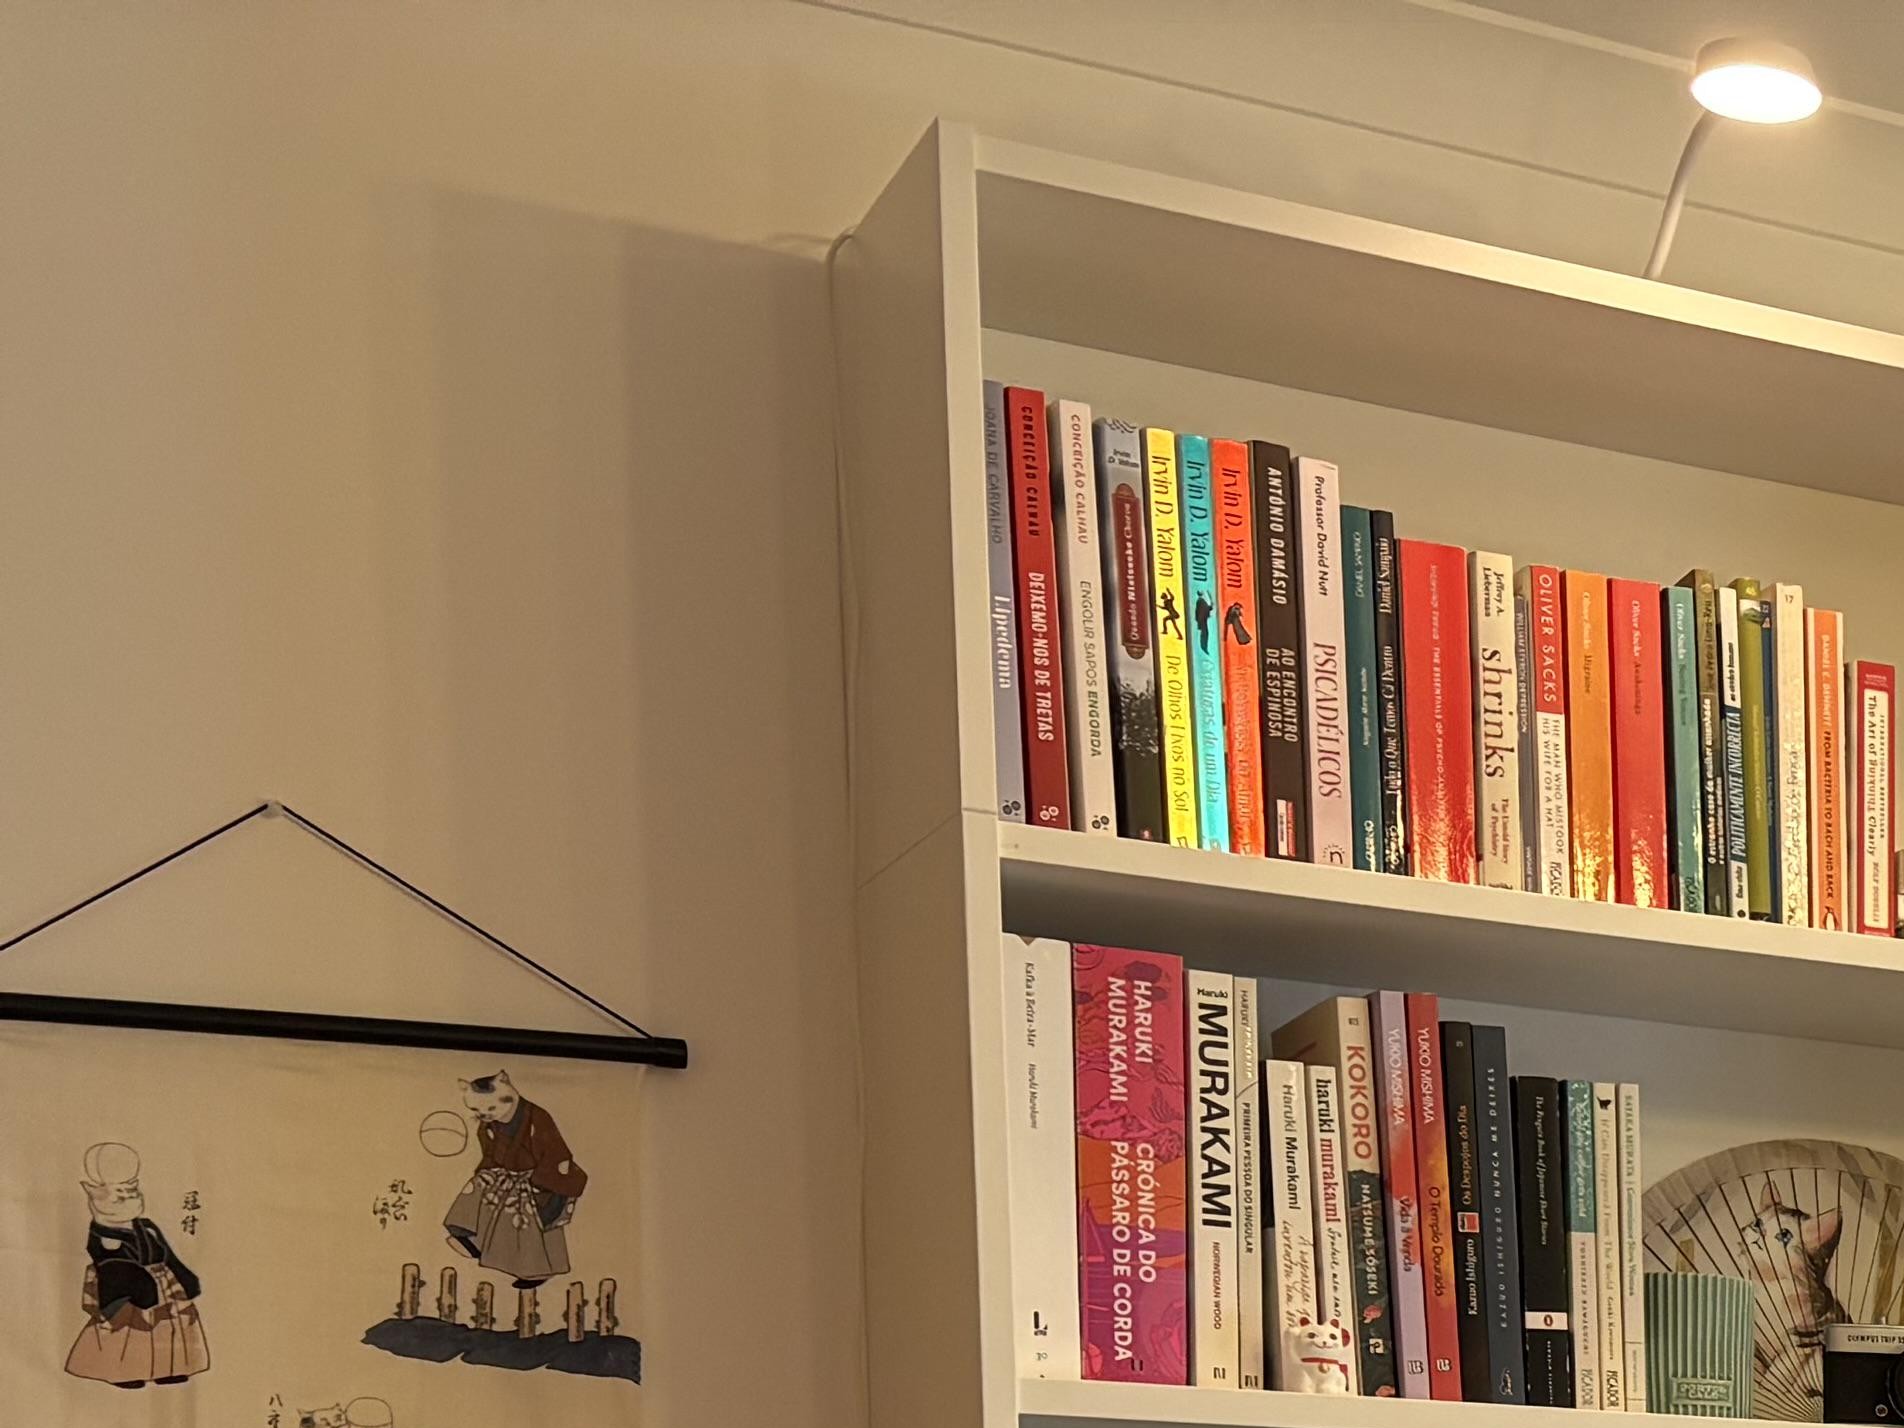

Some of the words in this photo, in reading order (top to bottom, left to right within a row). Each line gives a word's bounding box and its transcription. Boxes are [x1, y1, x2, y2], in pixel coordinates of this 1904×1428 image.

[1151, 456, 1170, 496] Irvin
[1187, 460, 1205, 502] Irvin
[1267, 466, 1287, 532] ANTÓNIO
[1155, 501, 1173, 517] D.
[1188, 508, 1208, 524] D.
[1157, 528, 1174, 577] Yalom
[1191, 531, 1210, 582] Yalom
[1270, 538, 1288, 605] DAMÁSIO
[1539, 575, 1554, 635] OLIVER
[1266, 649, 1278, 664] DE
[1281, 648, 1295, 664] AO
[1543, 643, 1556, 703] SACKS
[1267, 668, 1282, 737] ESPINOSA
[1282, 670, 1298, 742] ENCONTRO
[1312, 642, 1344, 799] PSICADÉLICOS
[1482, 648, 1515, 778] shrinks
[1868, 695, 1878, 717] The
[1868, 722, 1877, 739] Art
[1869, 743, 1876, 755] of
[1866, 816, 1876, 856] Clearly
[1107, 977, 1129, 1102] MURAKAMI
[1133, 980, 1153, 1064] HARUKI
[1197, 1002, 1232, 1229] MURAKAMI
[1281, 1084, 1296, 1132] Haruki
[1316, 1078, 1335, 1134] haruki
[1346, 1045, 1373, 1161] KOKORO
[1110, 1140, 1131, 1243] PÁSSARO
[1136, 1141, 1157, 1241] CRÓNICA
[1285, 1135, 1302, 1210] Murakami
[1319, 1137, 1341, 1223] murakami
[1111, 1248, 1130, 1277] DE
[1138, 1248, 1157, 1283] DO
[1113, 1283, 1133, 1362] CORDA
